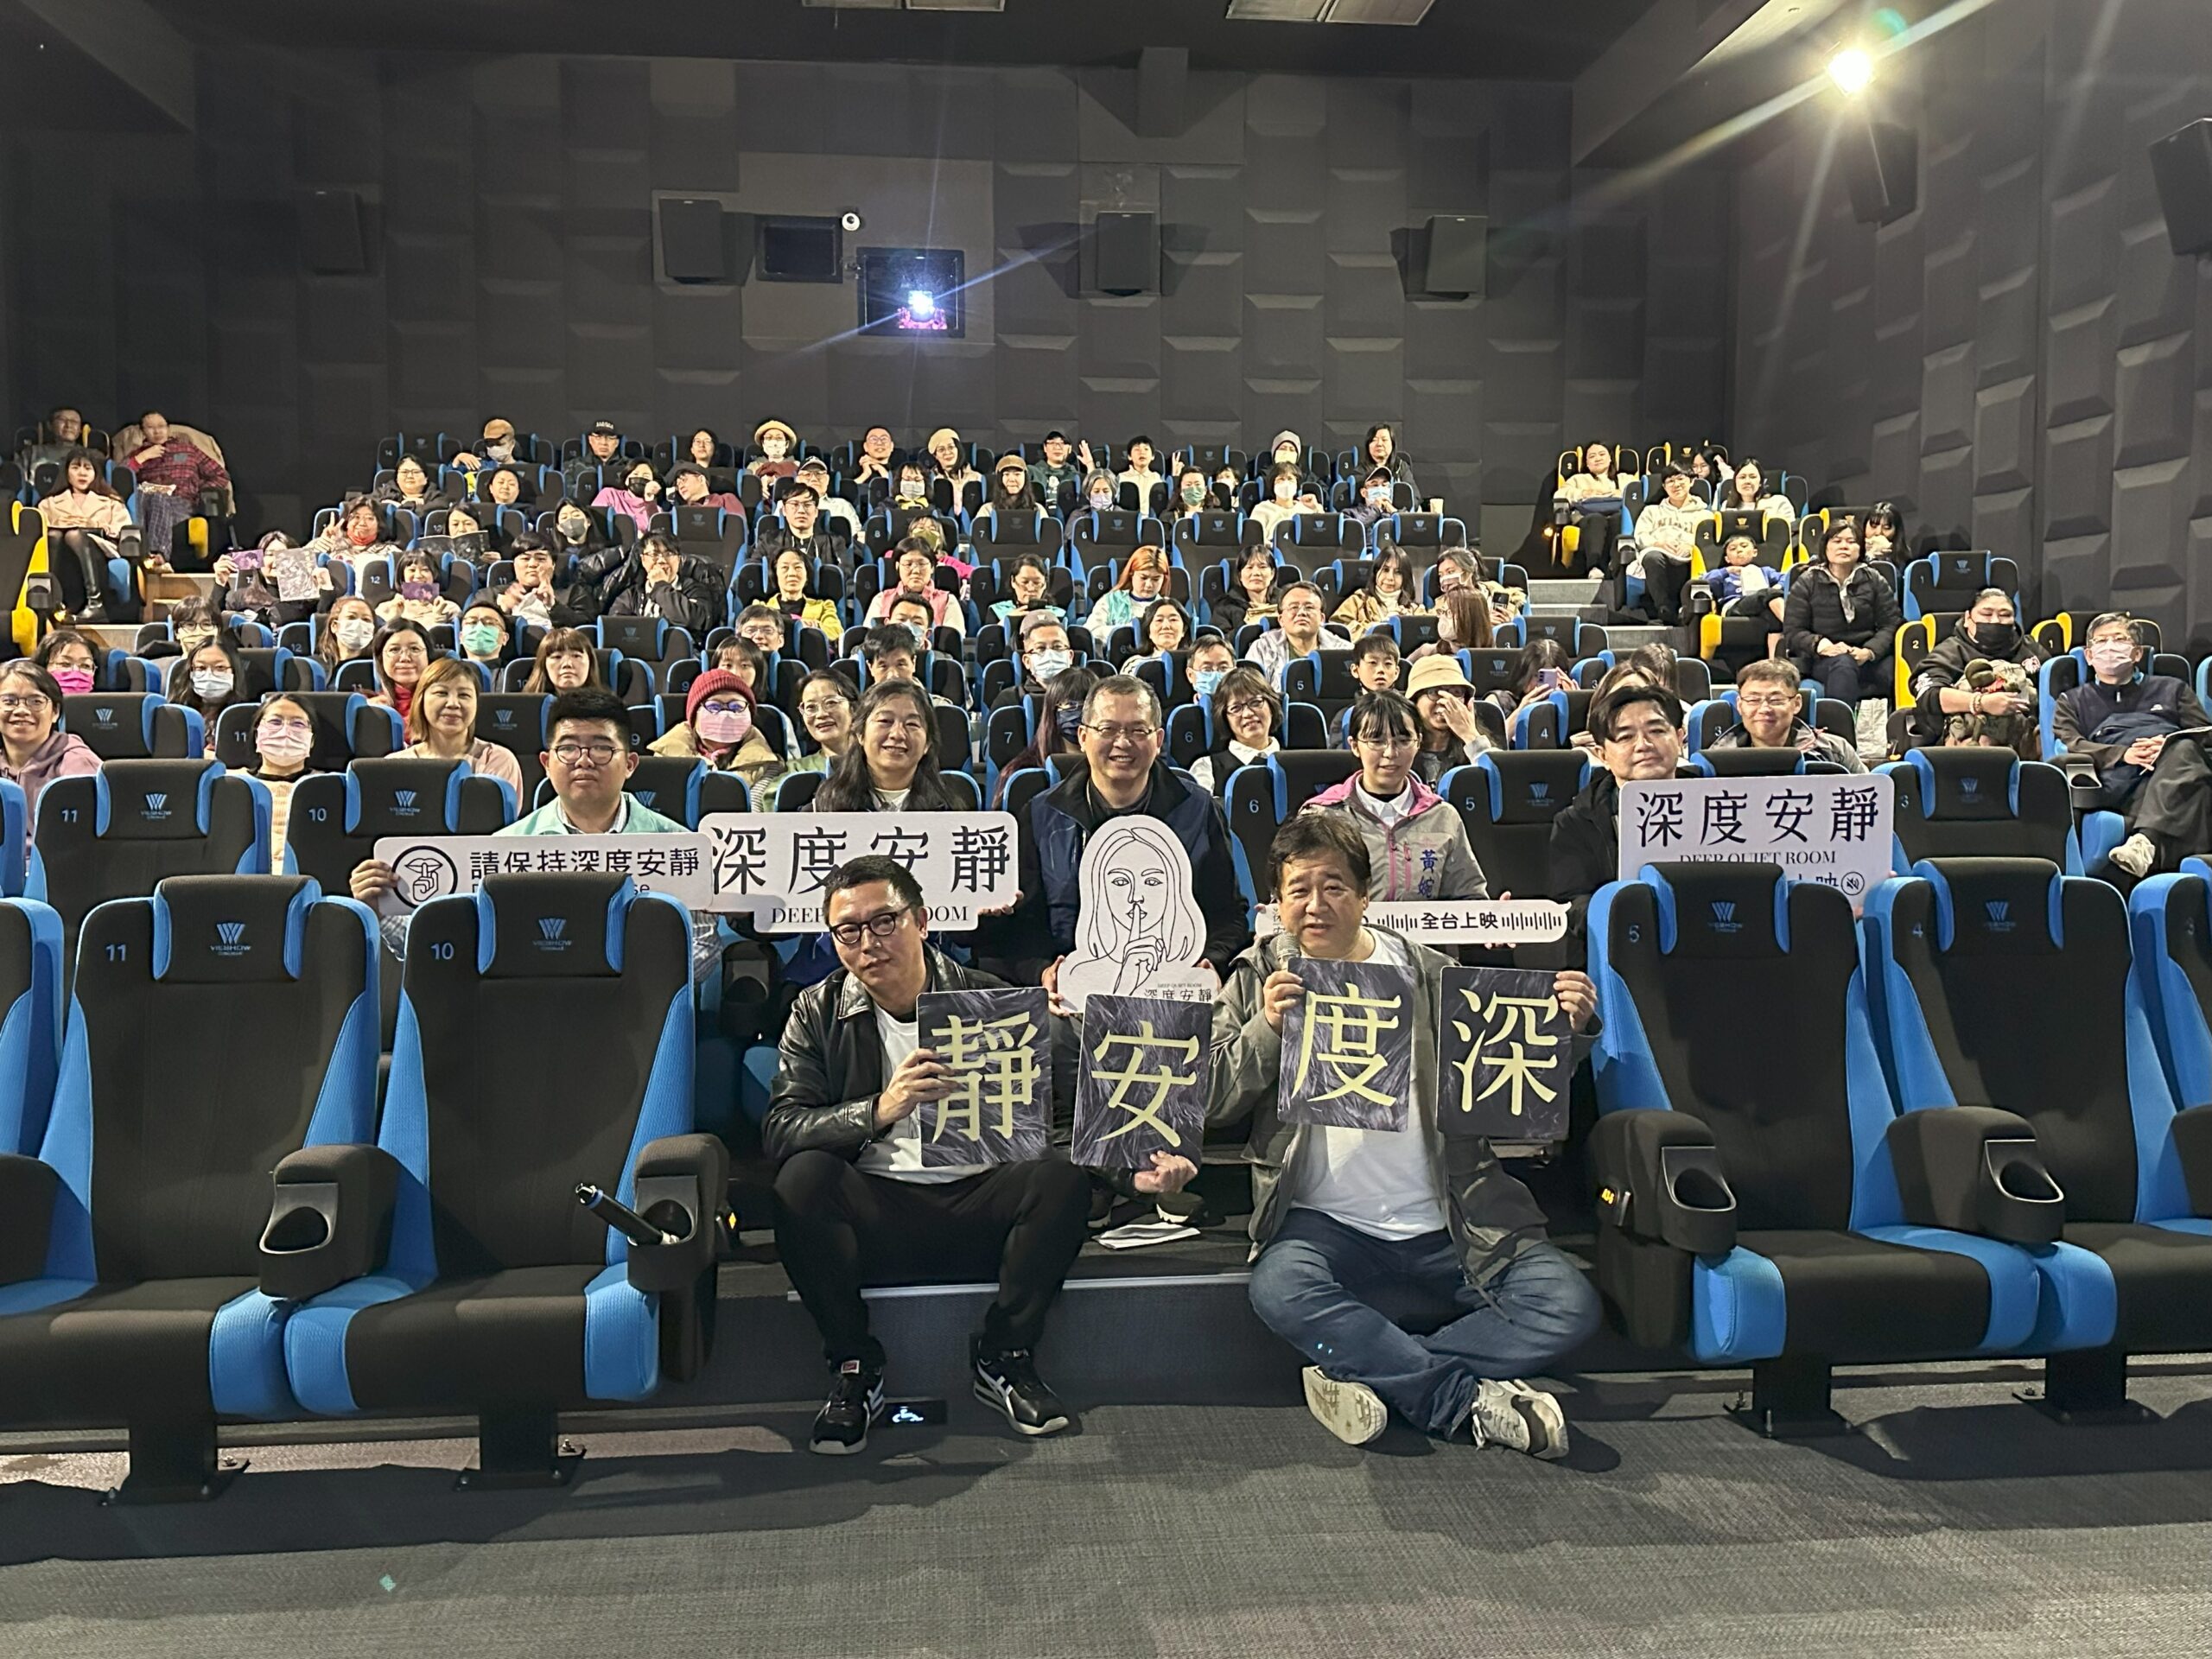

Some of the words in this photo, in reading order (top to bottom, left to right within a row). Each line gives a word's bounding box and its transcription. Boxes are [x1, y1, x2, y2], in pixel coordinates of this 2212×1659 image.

[1912, 640, 1919, 649] 2
[2049, 639, 2053, 648] 1
[682, 681, 690, 691] 9
[997, 681, 1003, 690] 7
[1298, 680, 1304, 690] 5
[234, 732, 246, 741] 11
[1004, 732, 1013, 744] 7
[1185, 732, 1193, 743] 6
[1541, 728, 1548, 739] 4
[1715, 726, 1721, 737] 3
[631, 734, 640, 746] 9
[1249, 799, 1259, 813] 6
[1465, 798, 1475, 810] 5
[1901, 795, 1909, 808] 3
[61, 809, 77, 823] 11
[309, 808, 327, 821] 10
[1636, 786, 1878, 848] 深度安靜
[470, 848, 699, 880] 請保持深度安靜
[1785, 850, 1835, 865] ROOM
[1421, 912, 1499, 930] 全台上映
[1629, 925, 1640, 943] 5
[1912, 923, 1923, 938] 4
[106, 944, 126, 961] 11
[431, 943, 454, 960] 10
[1290, 982, 1402, 1107] 度
[1452, 988, 1559, 1116] 深
[931, 1011, 1041, 1145] 靜
[1091, 1020, 1199, 1147] 安
